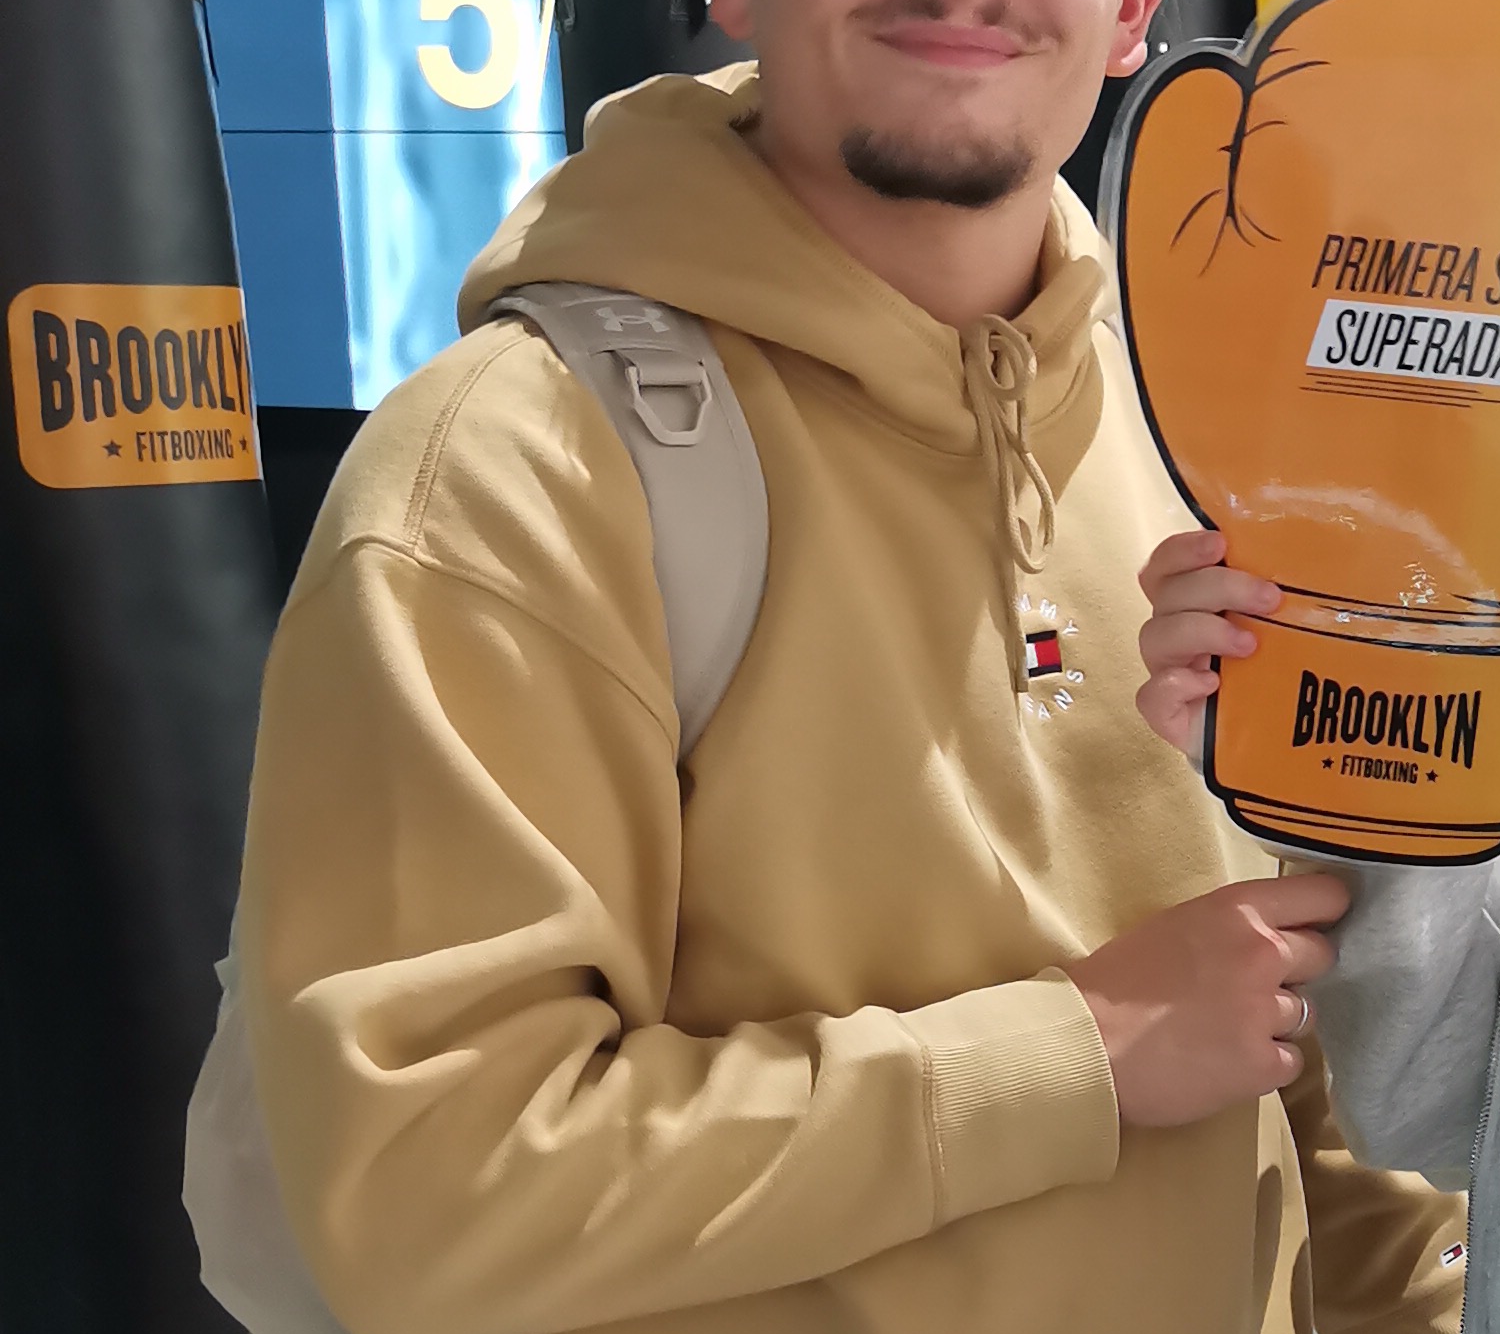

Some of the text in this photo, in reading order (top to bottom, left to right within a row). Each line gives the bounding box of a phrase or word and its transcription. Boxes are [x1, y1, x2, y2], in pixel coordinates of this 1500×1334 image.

[1311, 233, 1482, 304] PRIMERA
[33, 308, 253, 433] BROOKLY
[135, 428, 235, 463] FITBOXING
[1292, 669, 1482, 770] BROOKLYN
[1340, 753, 1419, 785] FITBOXING
